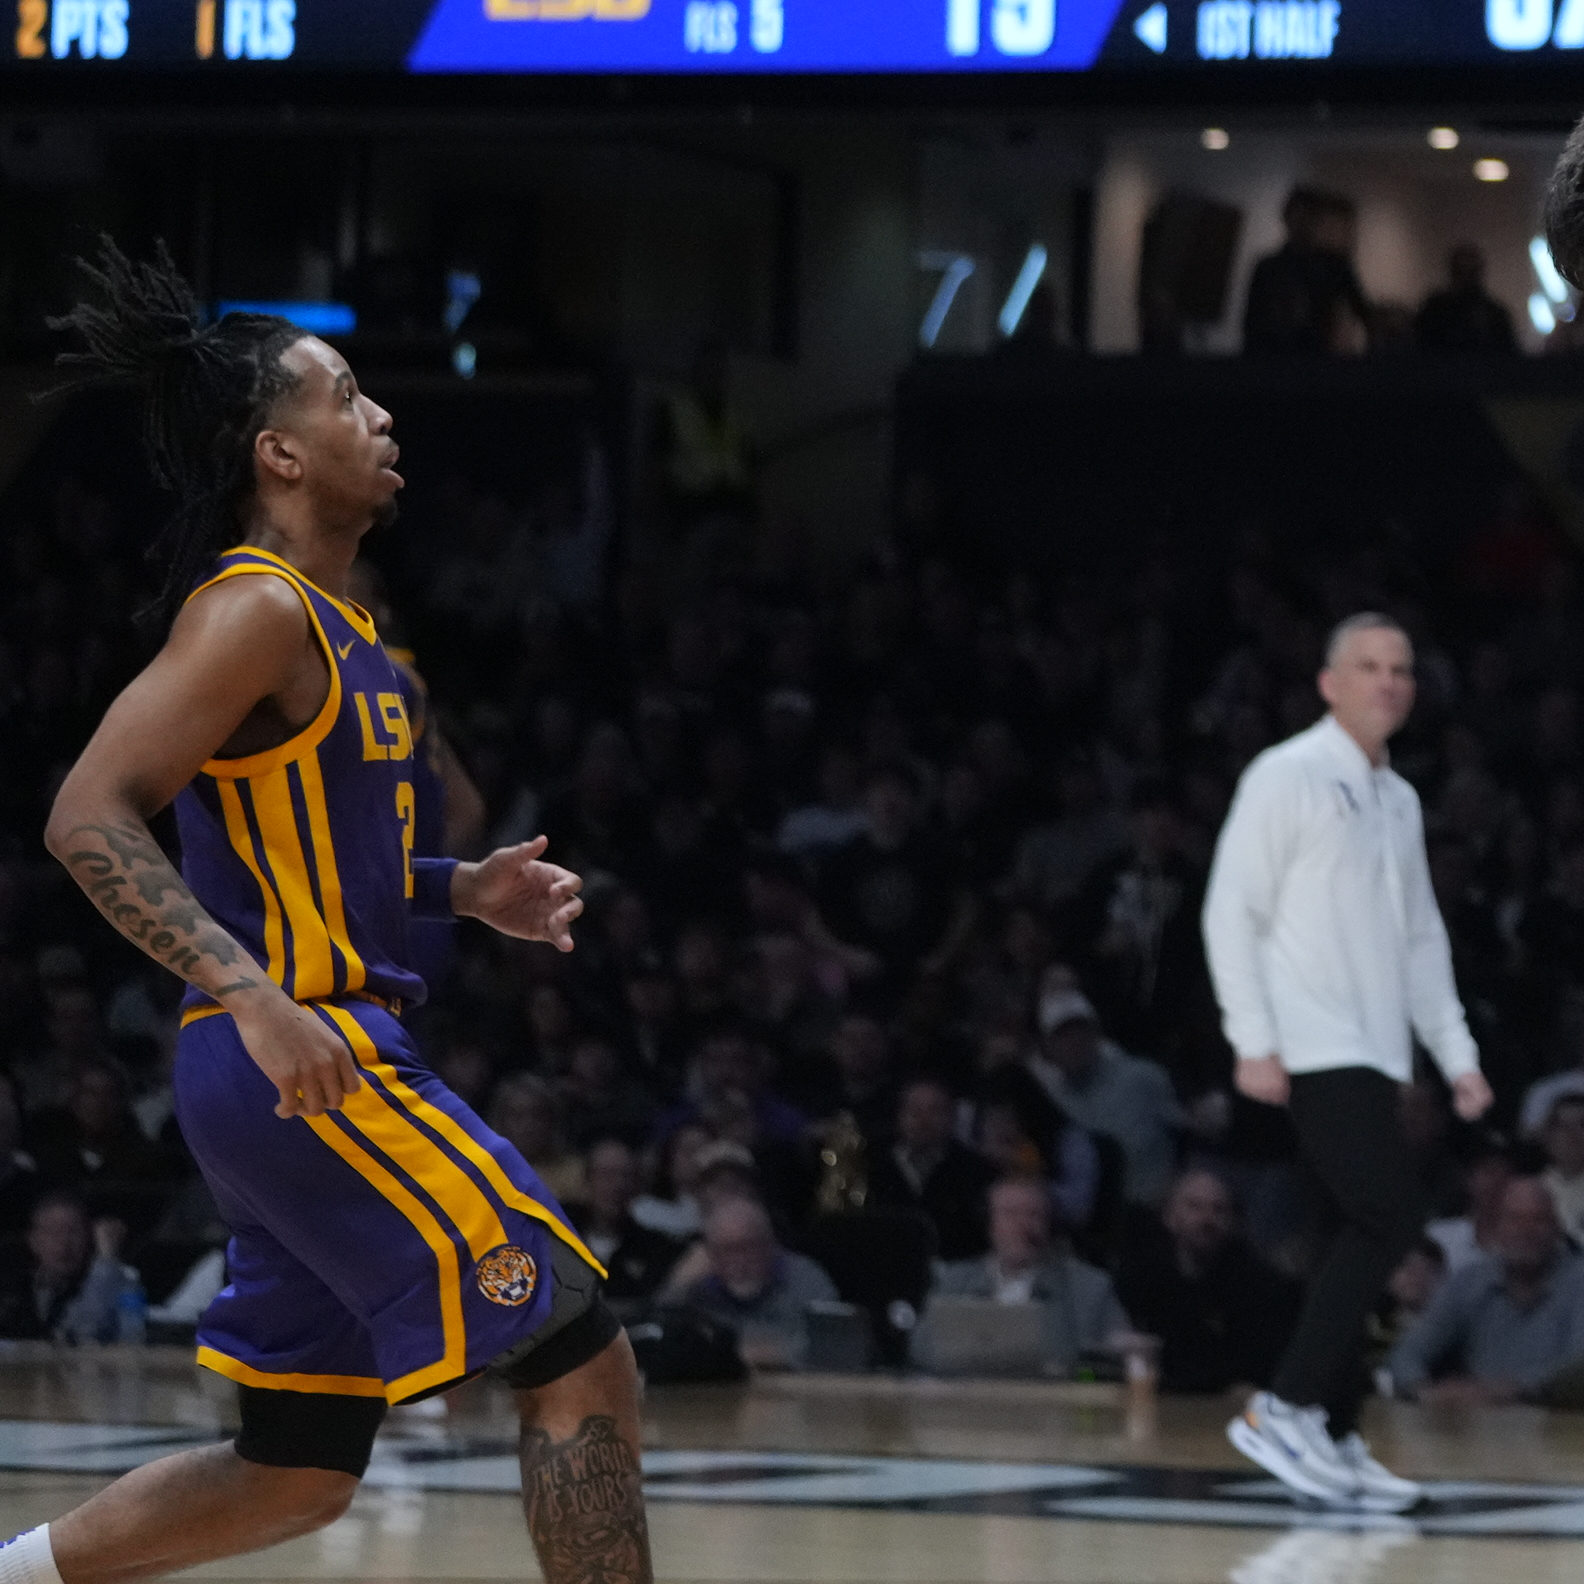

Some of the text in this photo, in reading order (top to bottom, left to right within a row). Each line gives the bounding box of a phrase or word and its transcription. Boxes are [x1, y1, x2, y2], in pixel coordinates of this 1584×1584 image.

[684, 0, 738, 53] FLS
[1197, 0, 1252, 59] 1ST
[353, 692, 414, 761] LS
[396, 782, 415, 898] 2
